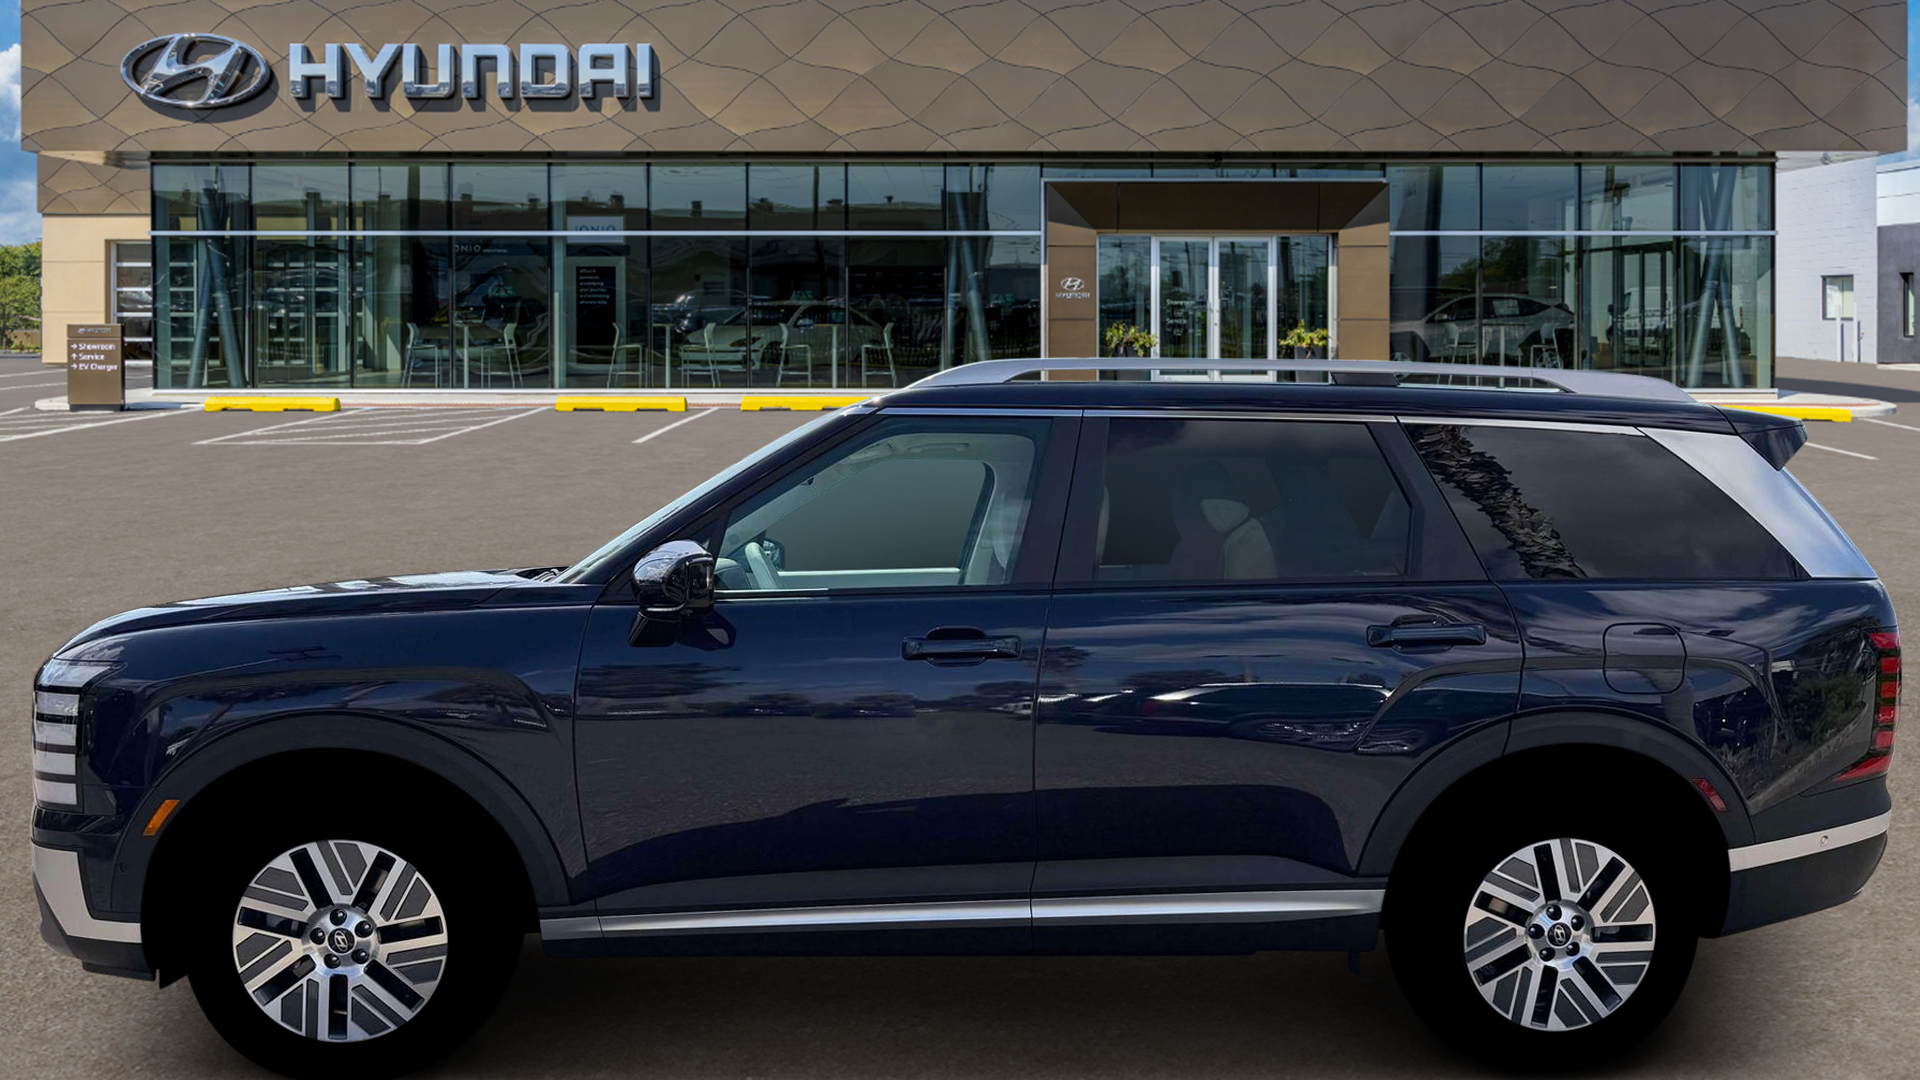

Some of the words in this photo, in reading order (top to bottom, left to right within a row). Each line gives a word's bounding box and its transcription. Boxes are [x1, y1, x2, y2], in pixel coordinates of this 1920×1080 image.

[289, 42, 657, 101] HYUNDAI
[78, 343, 116, 351] Showroom
[78, 352, 105, 360] Service
[90, 363, 118, 372] Charger
